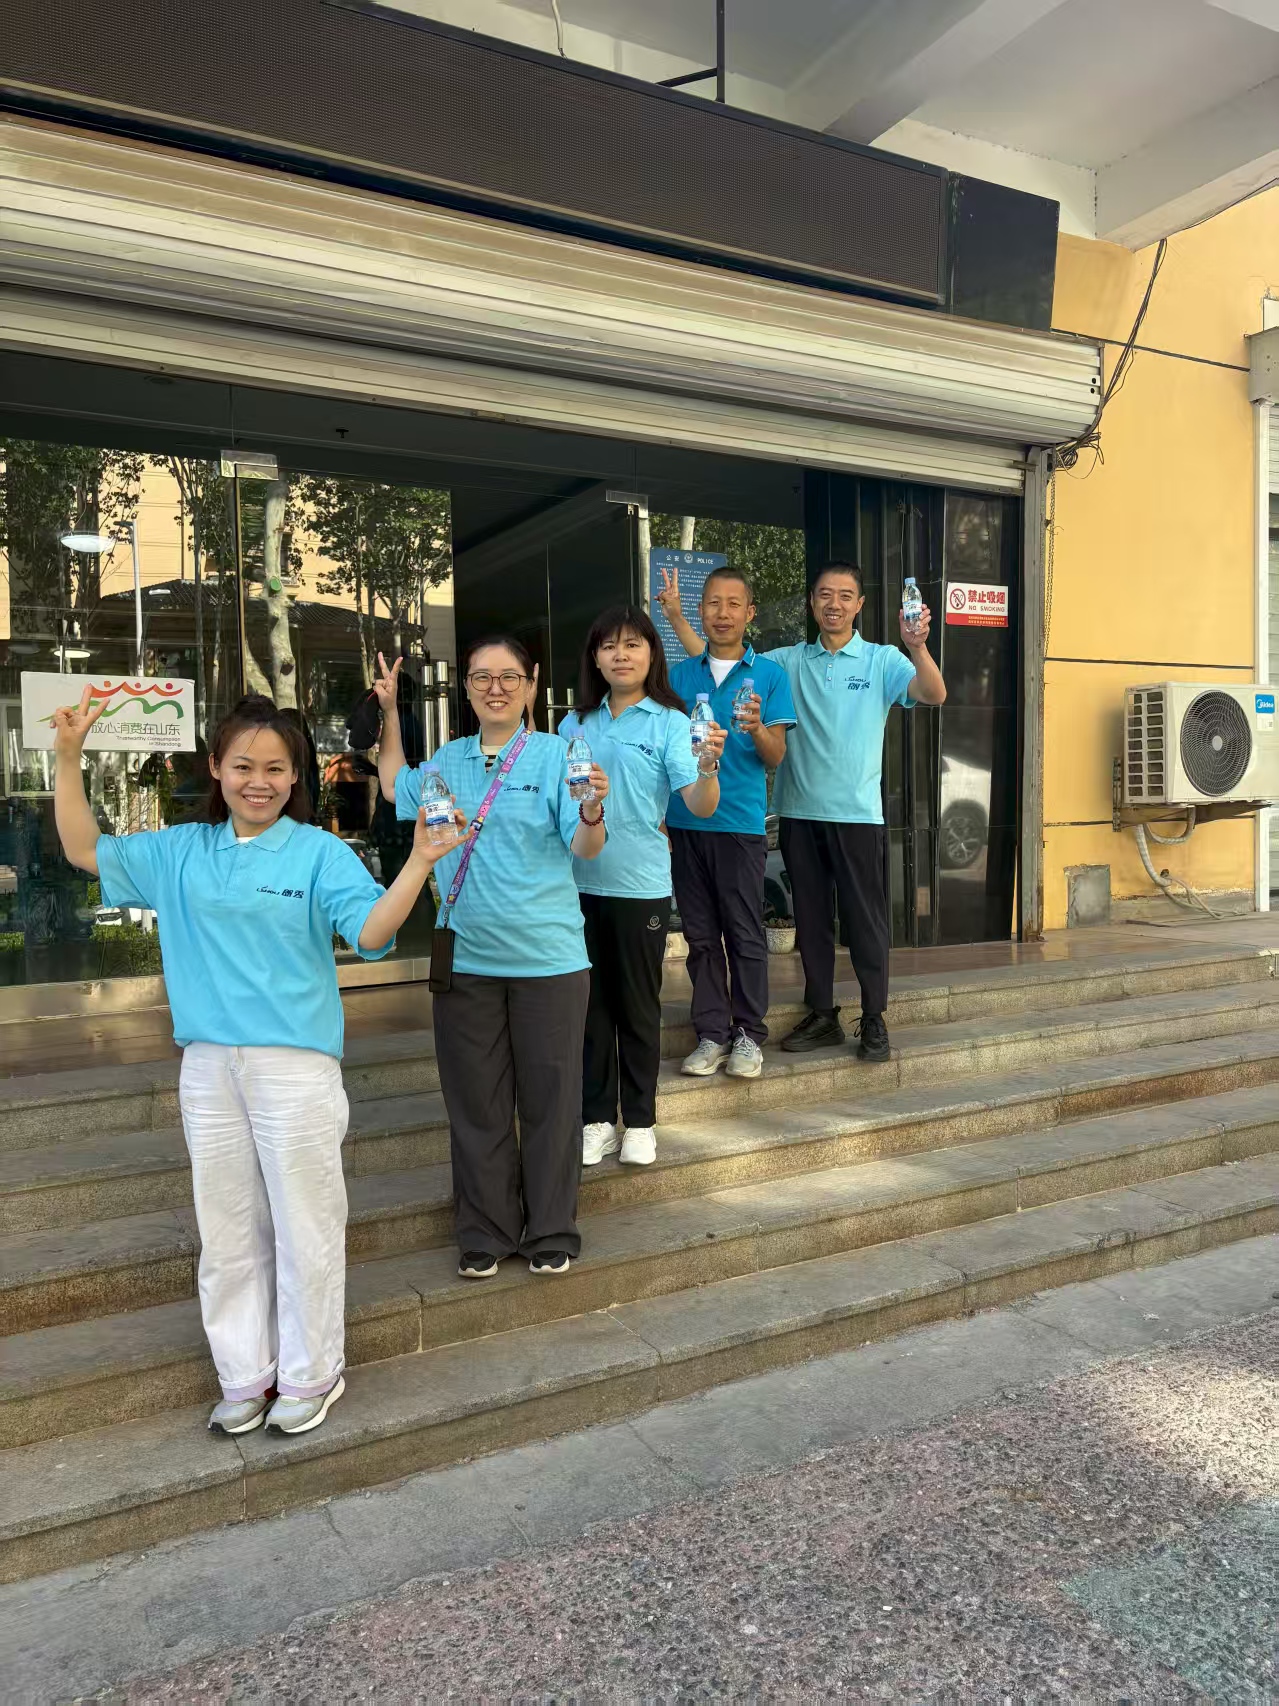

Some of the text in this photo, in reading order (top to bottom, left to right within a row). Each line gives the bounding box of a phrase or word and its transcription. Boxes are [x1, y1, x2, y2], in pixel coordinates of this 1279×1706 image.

[697, 557, 714, 565] POLICE
[967, 589, 1005, 604] 禁止吸烟
[1256, 699, 1274, 708] Midea
[91, 721, 181, 736] 放心消费在山东
